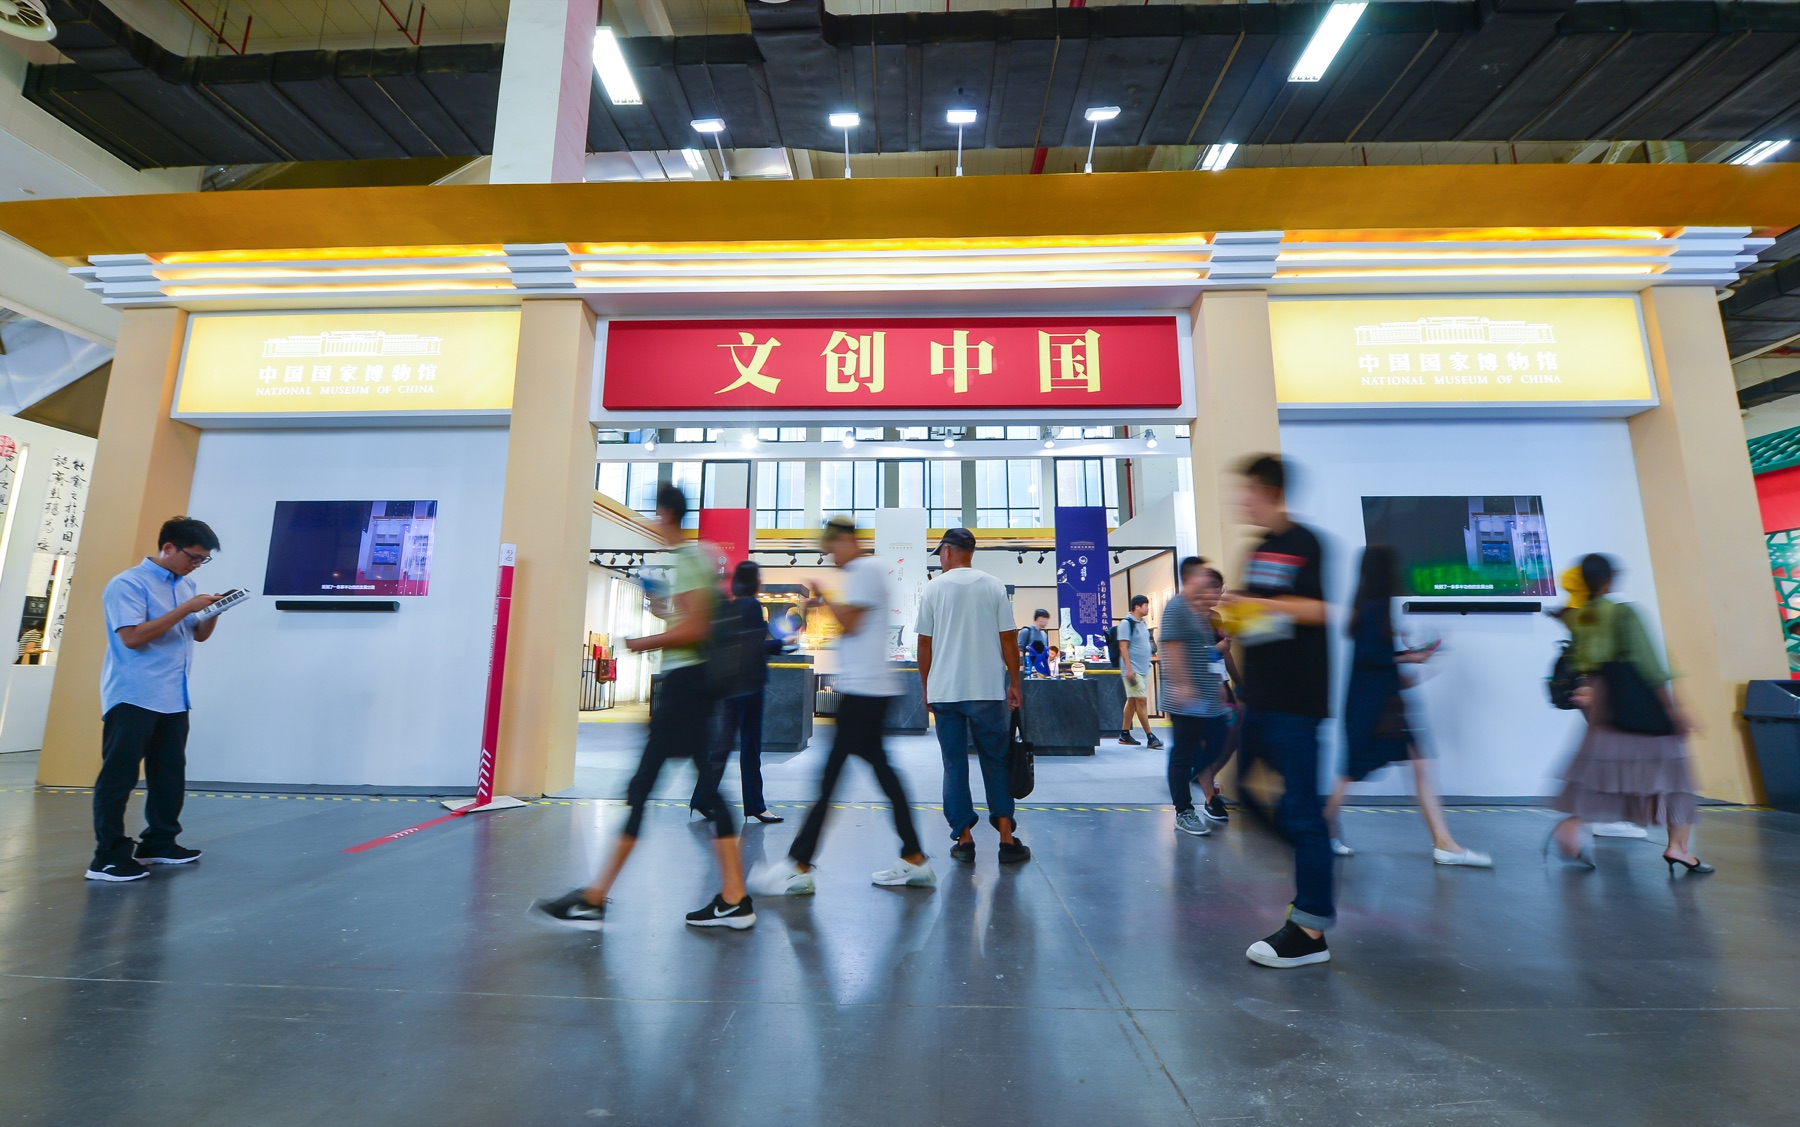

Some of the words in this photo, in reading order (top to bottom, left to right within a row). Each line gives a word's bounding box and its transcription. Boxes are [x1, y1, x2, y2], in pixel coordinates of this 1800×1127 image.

[714, 328, 1101, 395] 文创中国
[1358, 351, 1558, 373] 中国国家博物馆
[258, 363, 438, 384] 中国国家博物馆
[1361, 376, 1426, 386] NATIONAL
[1434, 375, 1489, 385] MUSEUM
[1496, 375, 1513, 384] OF
[1520, 374, 1562, 384] CHINA
[256, 387, 313, 396] NATIONAL
[320, 386, 370, 395] MUSEUM
[377, 385, 392, 395] OF
[397, 385, 435, 394] CHINA
